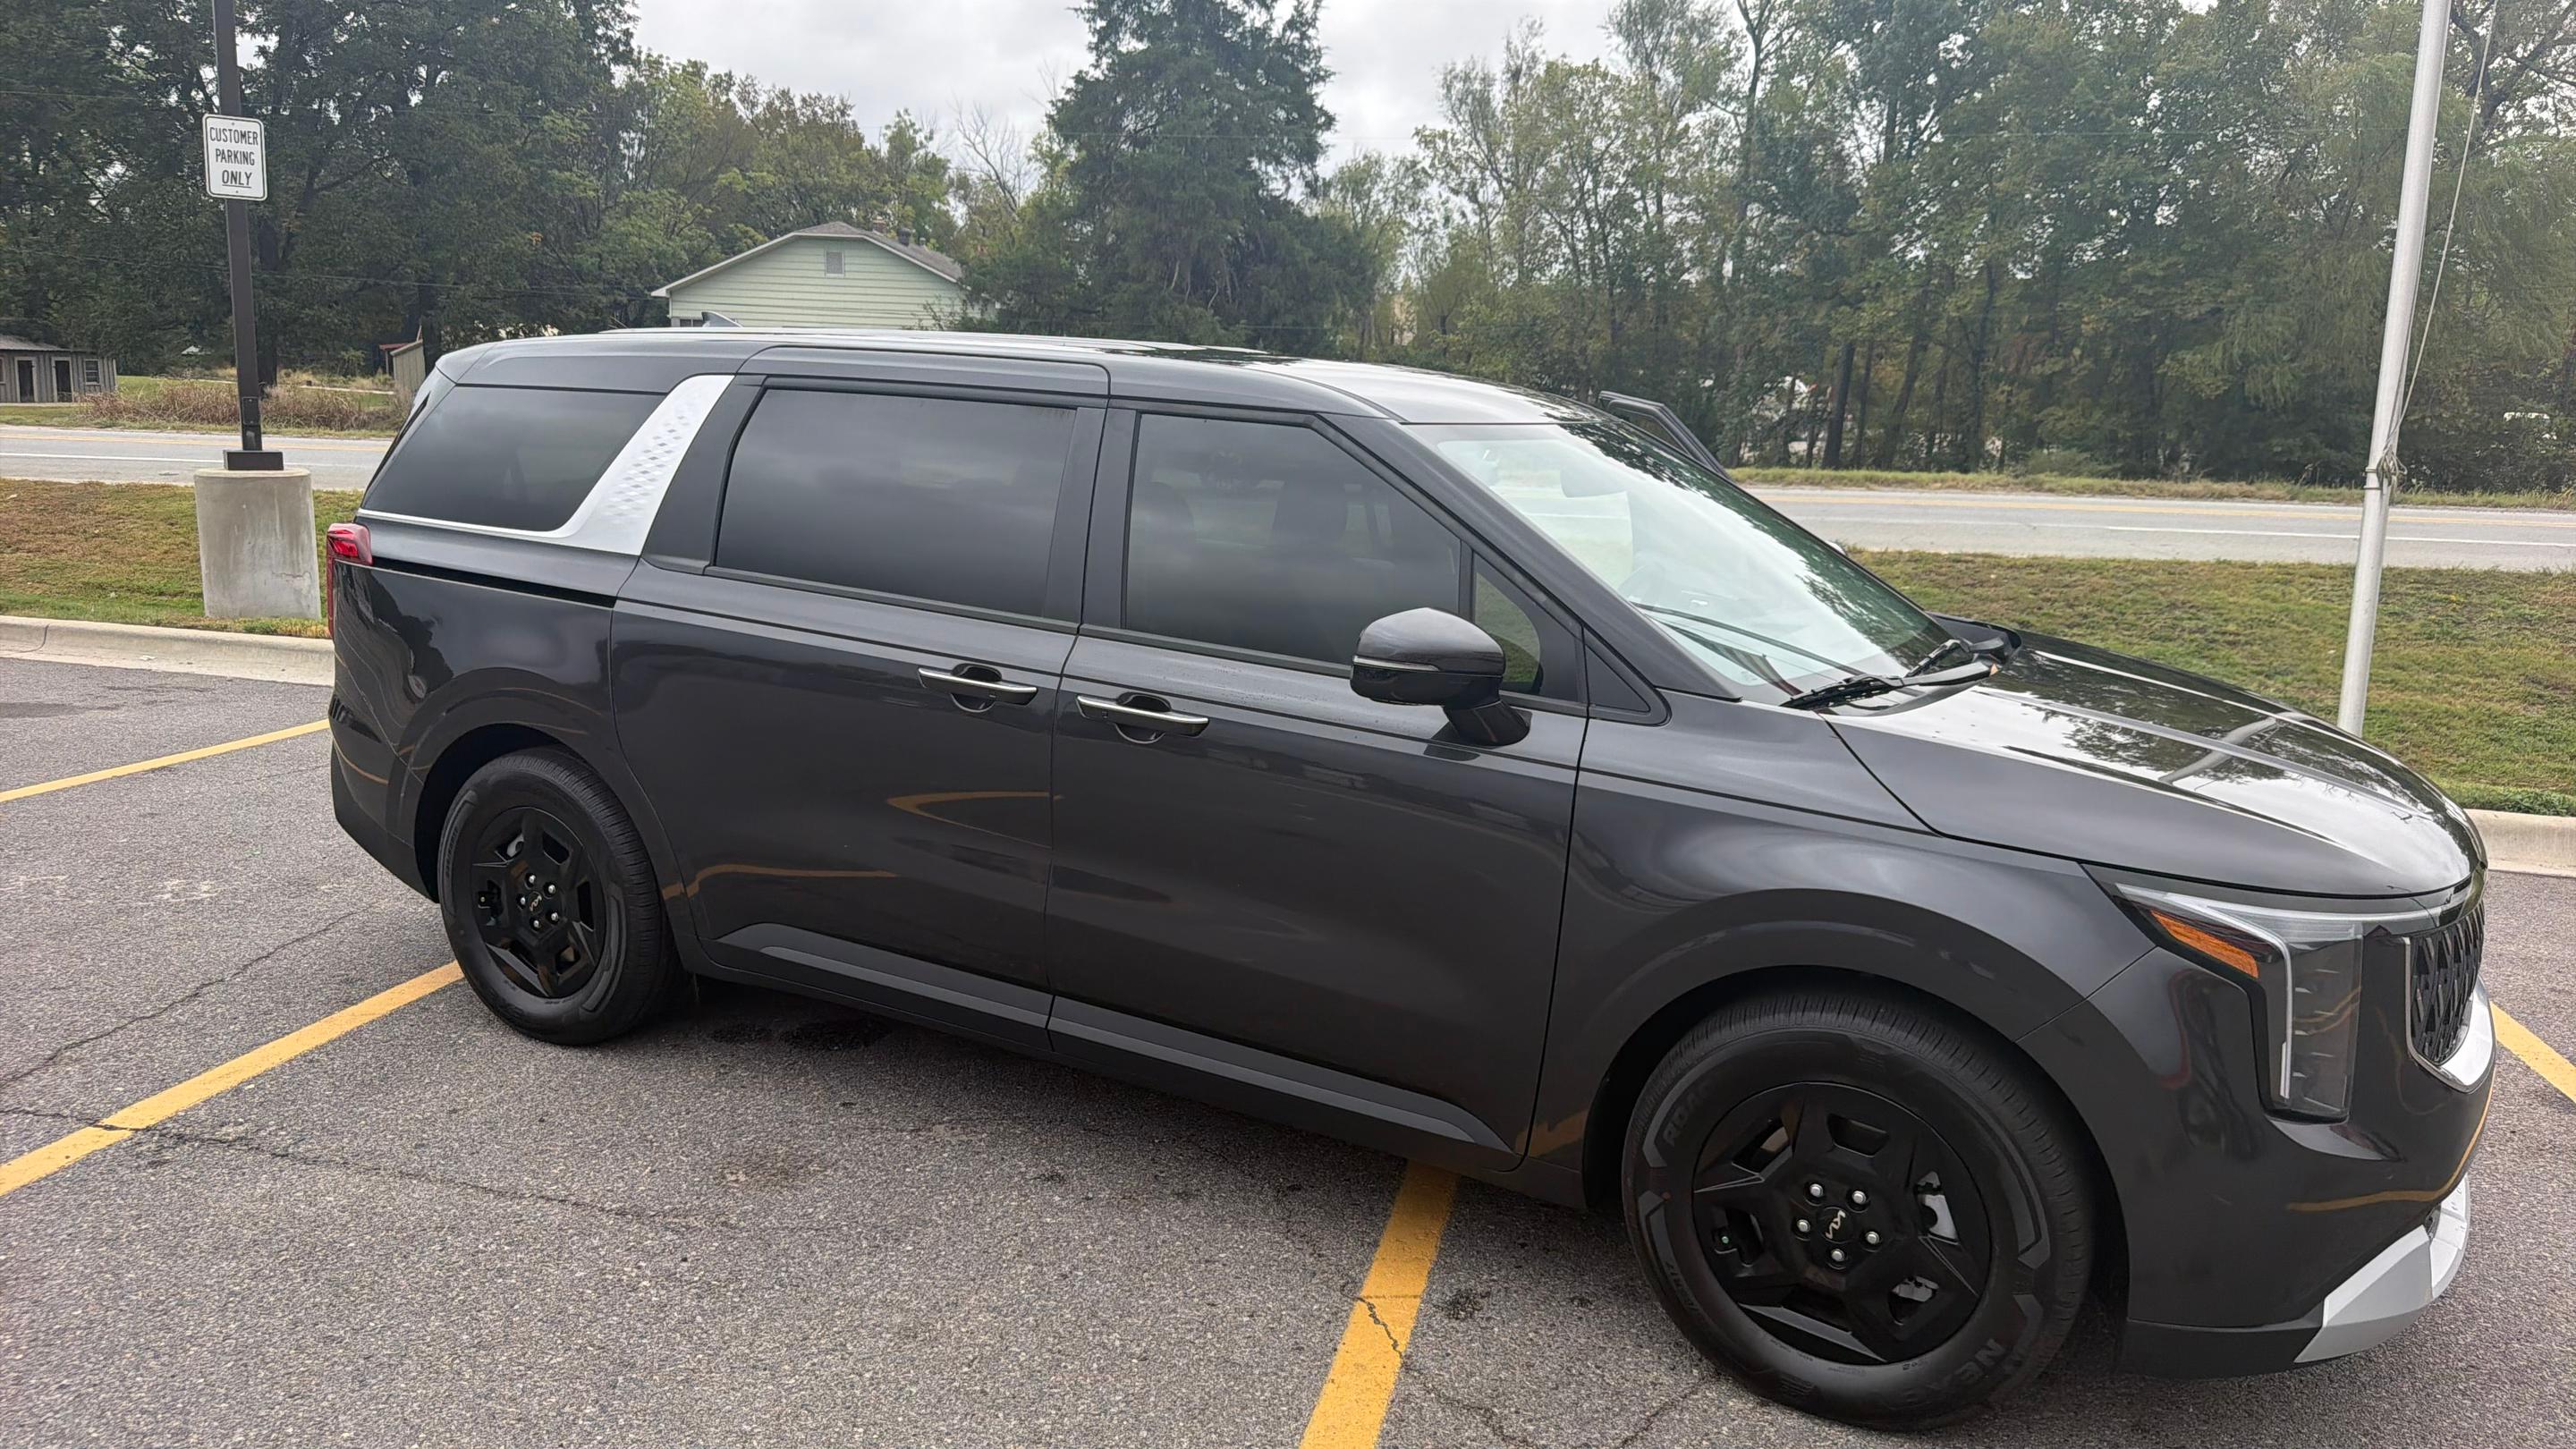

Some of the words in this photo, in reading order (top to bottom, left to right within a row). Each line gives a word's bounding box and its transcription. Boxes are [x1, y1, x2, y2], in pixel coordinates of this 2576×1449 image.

[209, 127, 258, 145] CUSTOMER
[215, 148, 255, 166] PARKING
[222, 170, 252, 185] ONLY
